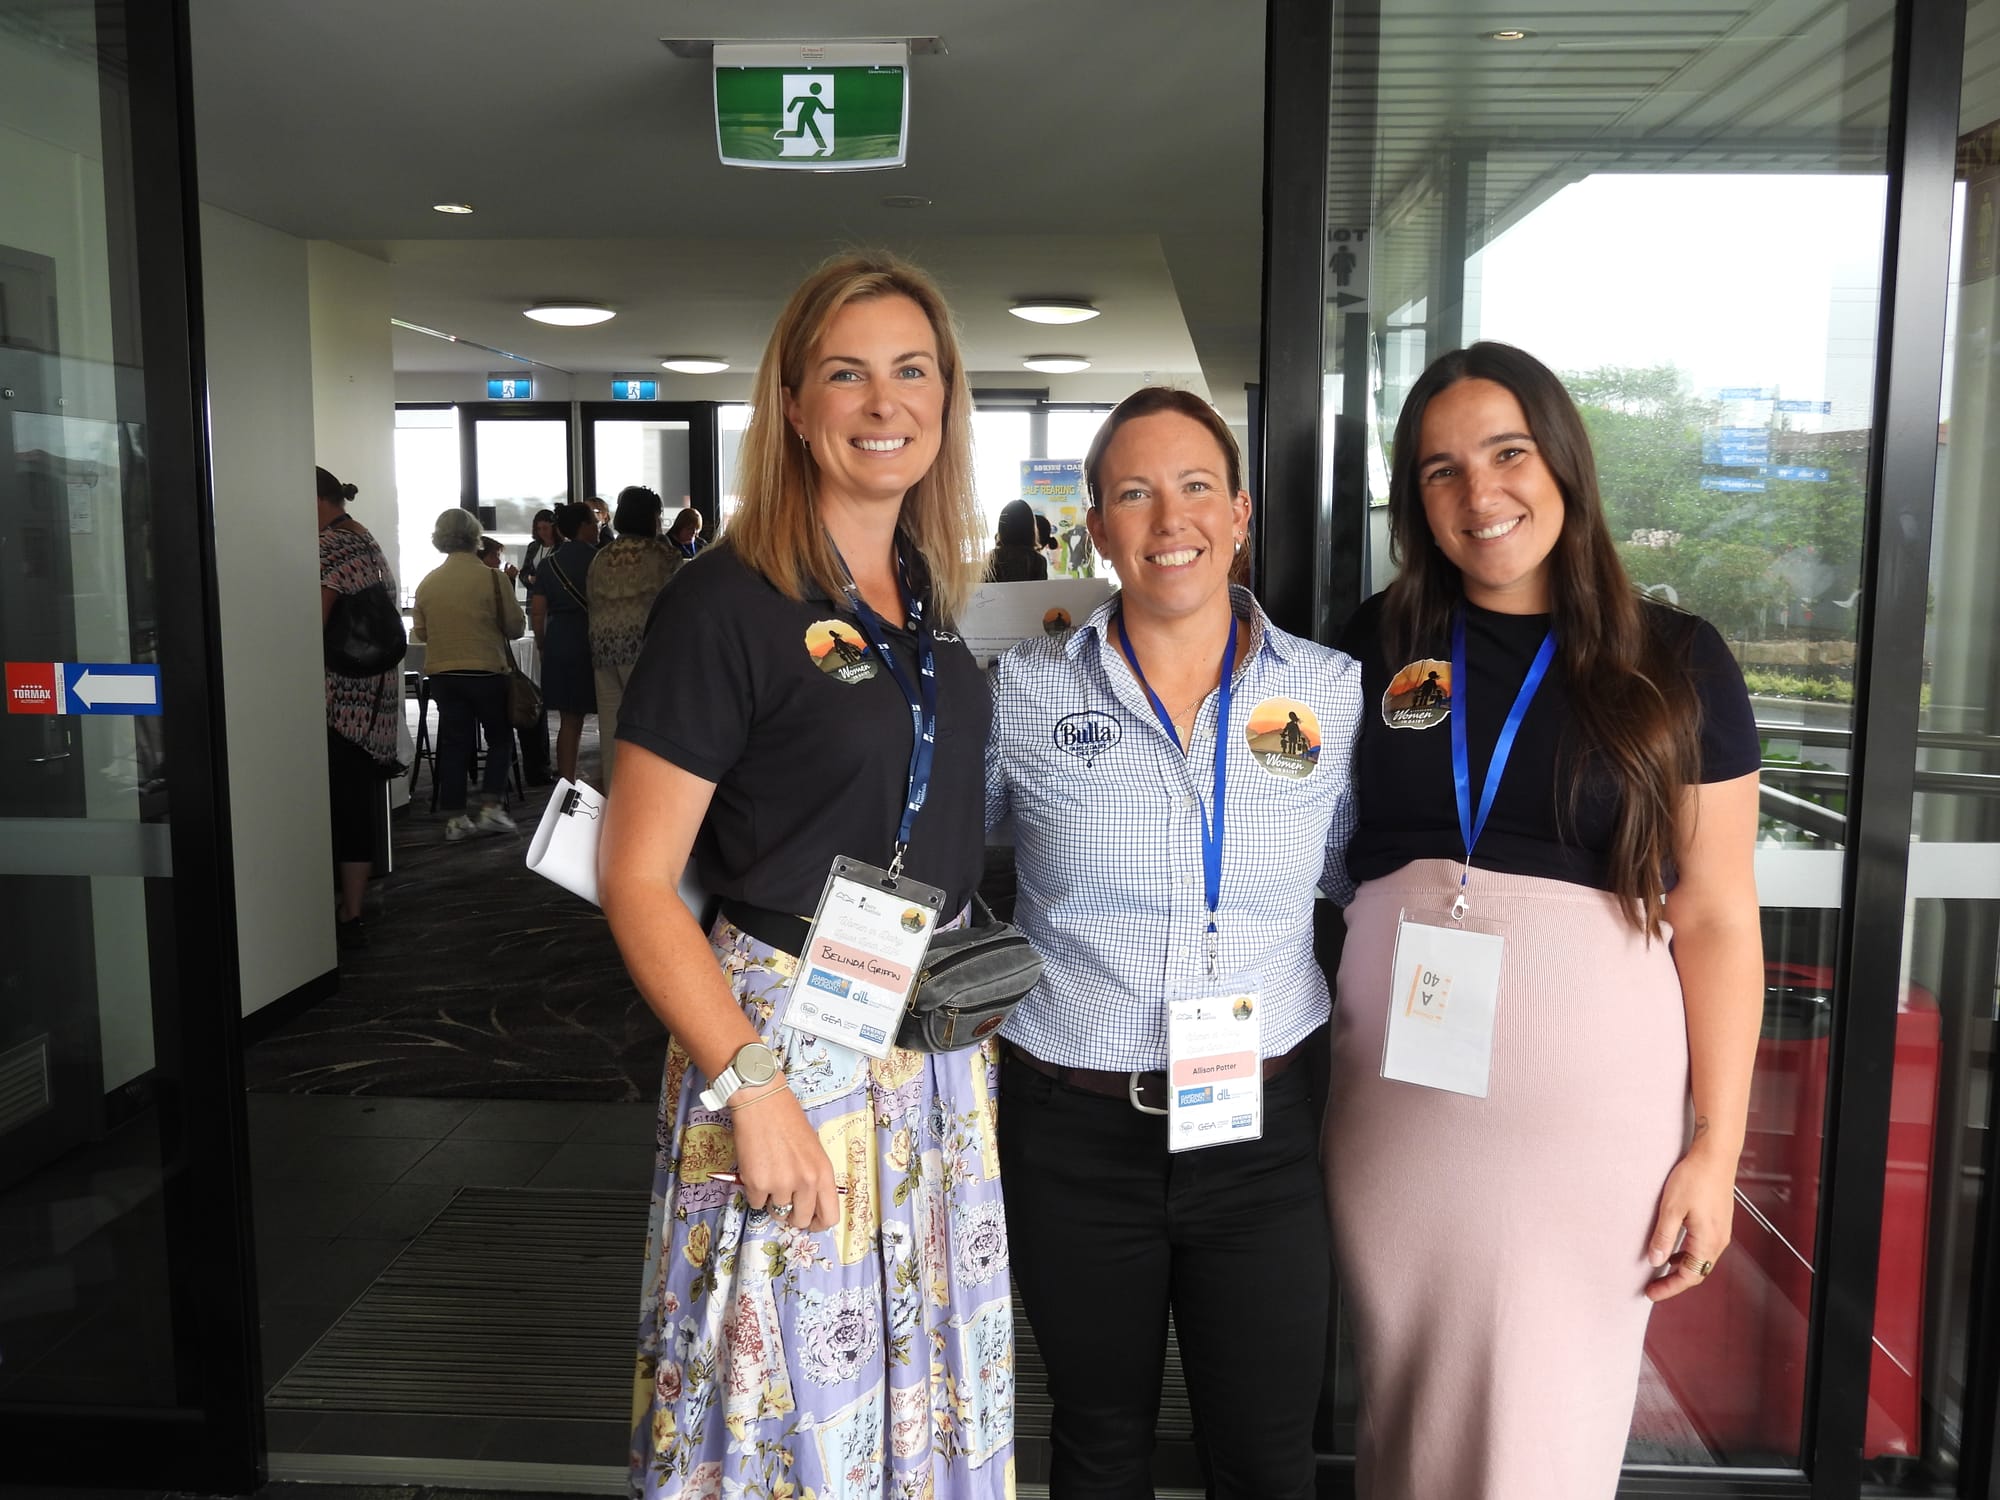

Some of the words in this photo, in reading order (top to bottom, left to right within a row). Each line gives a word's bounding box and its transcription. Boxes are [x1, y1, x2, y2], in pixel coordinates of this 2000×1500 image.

[1041, 485, 1075, 496] REARING
[838, 664, 871, 679] Women
[12, 689, 51, 699] TORMAX
[1393, 709, 1433, 720] Women
[1060, 721, 1112, 746] Bulla
[1266, 753, 1304, 769] Women
[821, 1013, 843, 1027] GEA
[1193, 1064, 1215, 1075] Allison
[1216, 1063, 1237, 1072] Potter
